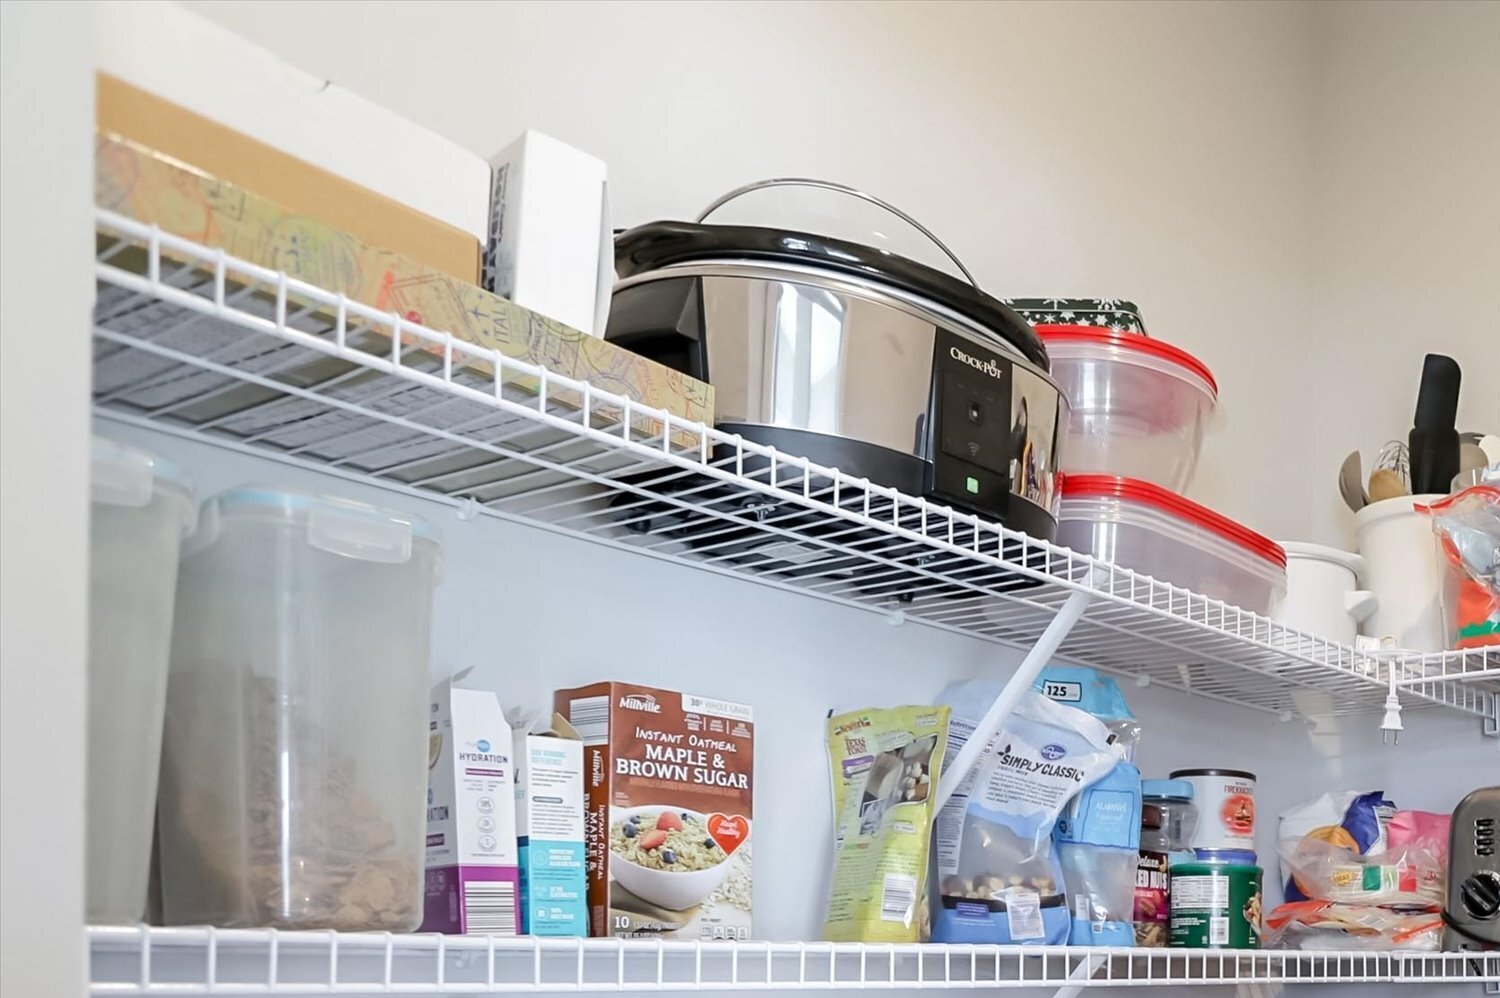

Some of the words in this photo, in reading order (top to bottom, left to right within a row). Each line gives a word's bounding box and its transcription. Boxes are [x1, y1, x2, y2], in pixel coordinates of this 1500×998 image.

[1047, 686, 1067, 697] 125
[619, 696, 662, 714] Millville
[636, 726, 683, 744] INSTANT
[688, 734, 738, 753] OATMEAL
[459, 752, 509, 765] HYDRATION
[645, 743, 707, 767] MAPLE
[712, 753, 726, 769] &
[616, 757, 688, 782] BROWN
[693, 767, 749, 790] SUGAR
[1000, 754, 1043, 773] SIMPLY
[1041, 763, 1085, 783] CLASSIC
[615, 916, 630, 929] 10
